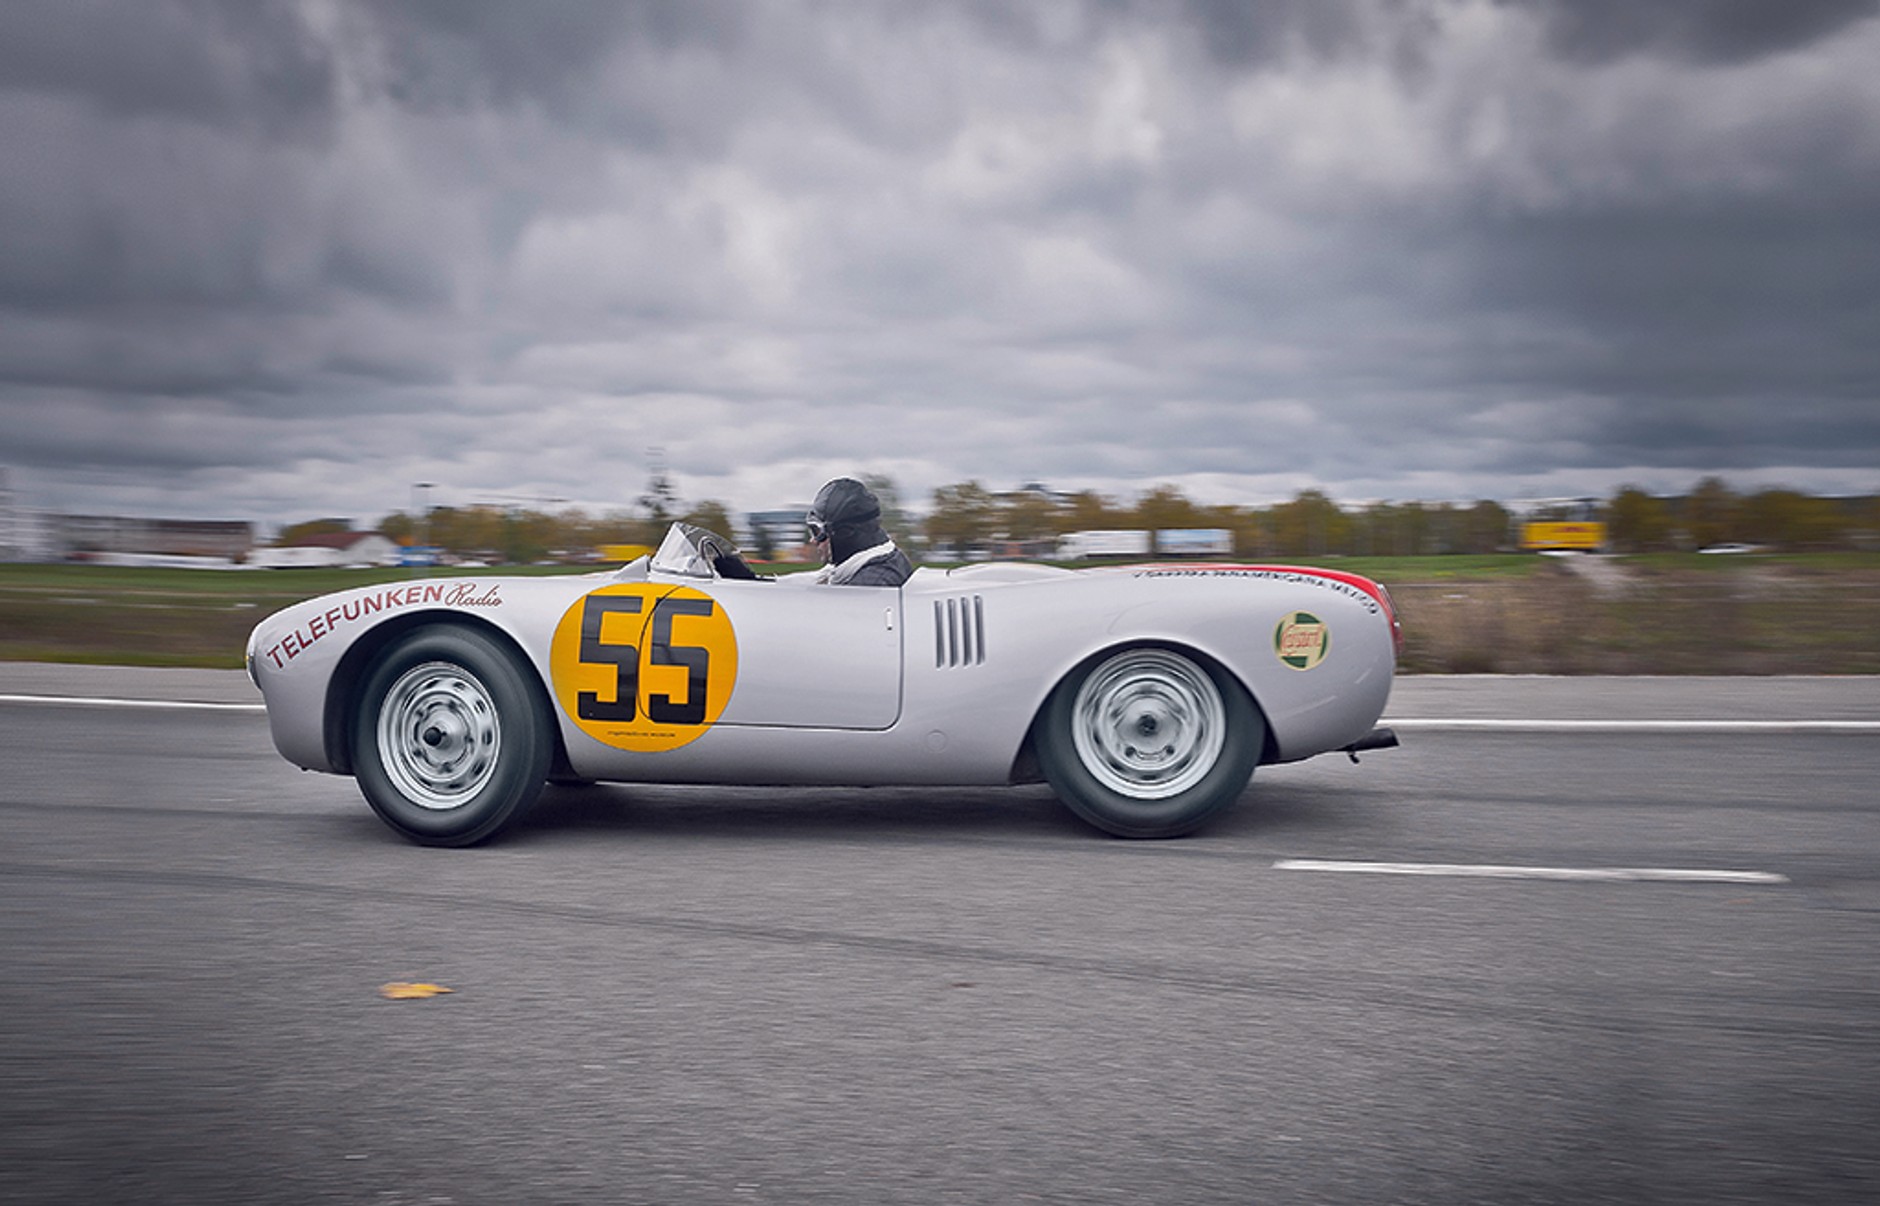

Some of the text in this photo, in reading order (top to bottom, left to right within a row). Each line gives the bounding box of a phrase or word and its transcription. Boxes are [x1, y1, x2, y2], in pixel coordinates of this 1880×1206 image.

[266, 583, 503, 669] TELEFUNKEN Radio
[577, 594, 714, 725] 55
